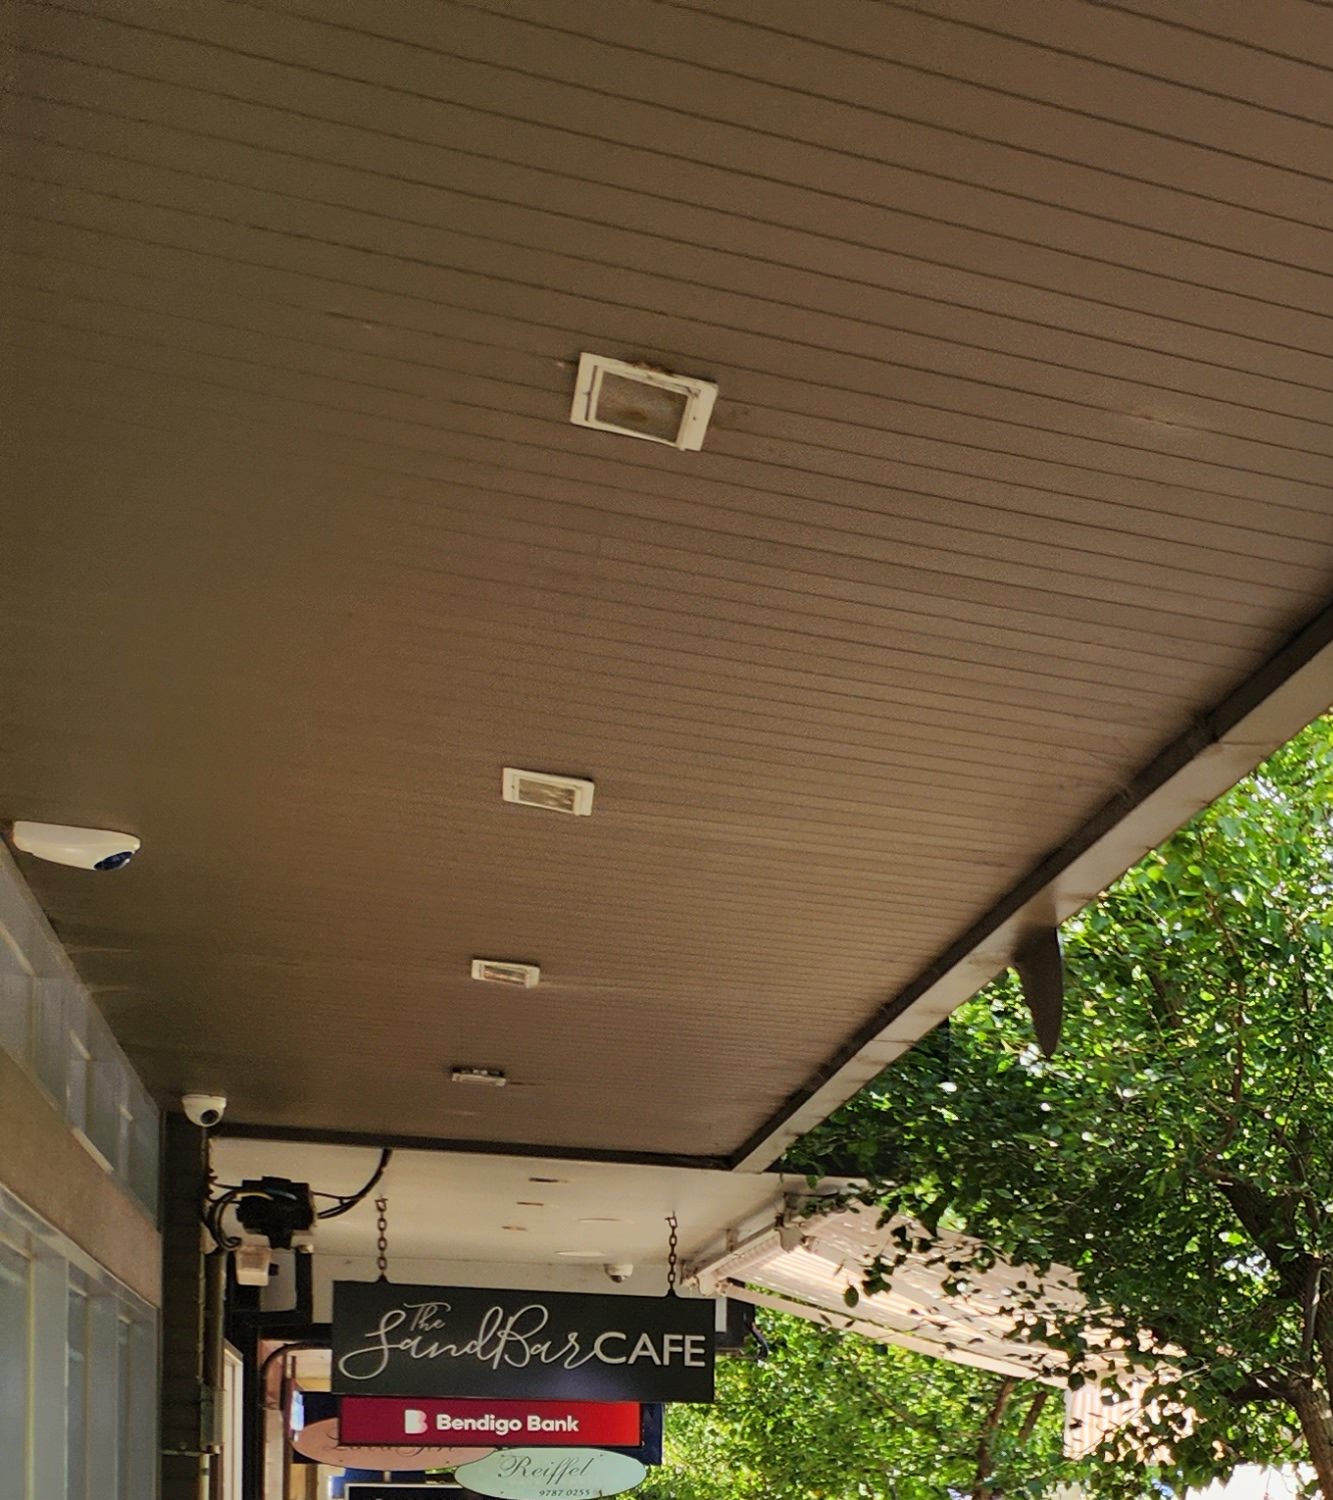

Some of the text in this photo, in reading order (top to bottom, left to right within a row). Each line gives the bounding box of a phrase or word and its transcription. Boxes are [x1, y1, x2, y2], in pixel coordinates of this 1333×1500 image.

[402, 1303, 452, 1334] The
[436, 1413, 580, 1436] Bendigo Bank
[498, 1454, 595, 1486] Reiffel
